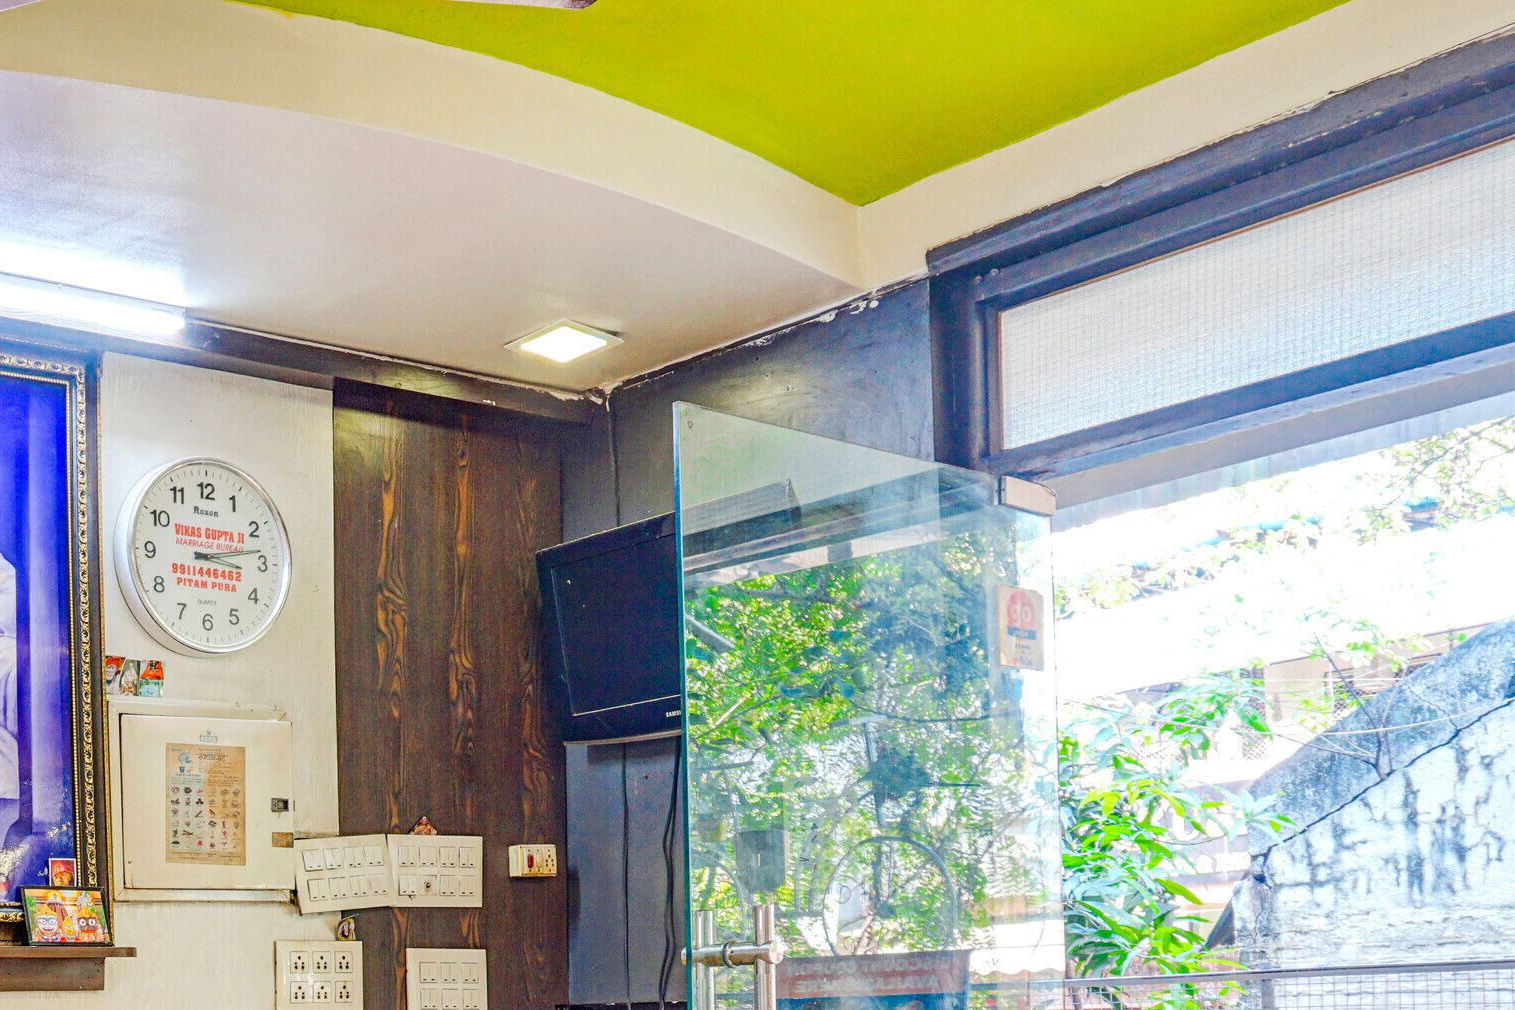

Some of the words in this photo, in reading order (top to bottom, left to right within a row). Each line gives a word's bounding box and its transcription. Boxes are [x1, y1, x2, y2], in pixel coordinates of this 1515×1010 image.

[170, 486, 185, 504] 11
[197, 482, 215, 500] 12
[229, 495, 237, 512] 1
[150, 510, 170, 527] 10
[174, 523, 202, 538] VIKAS
[205, 527, 235, 543] GUPTA
[249, 521, 260, 538] 2
[144, 541, 156, 559] 9
[175, 537, 215, 550] MARRIAGE
[216, 543, 244, 554] BUREAU
[171, 563, 242, 582] 9911446462
[258, 555, 268, 573] 3
[153, 576, 165, 593] 8
[177, 577, 208, 589] PITAM
[212, 582, 237, 592] PURA
[248, 588, 259, 604] 4
[177, 602, 187, 620] 7
[229, 608, 239, 625] 5
[202, 613, 213, 631] 6
